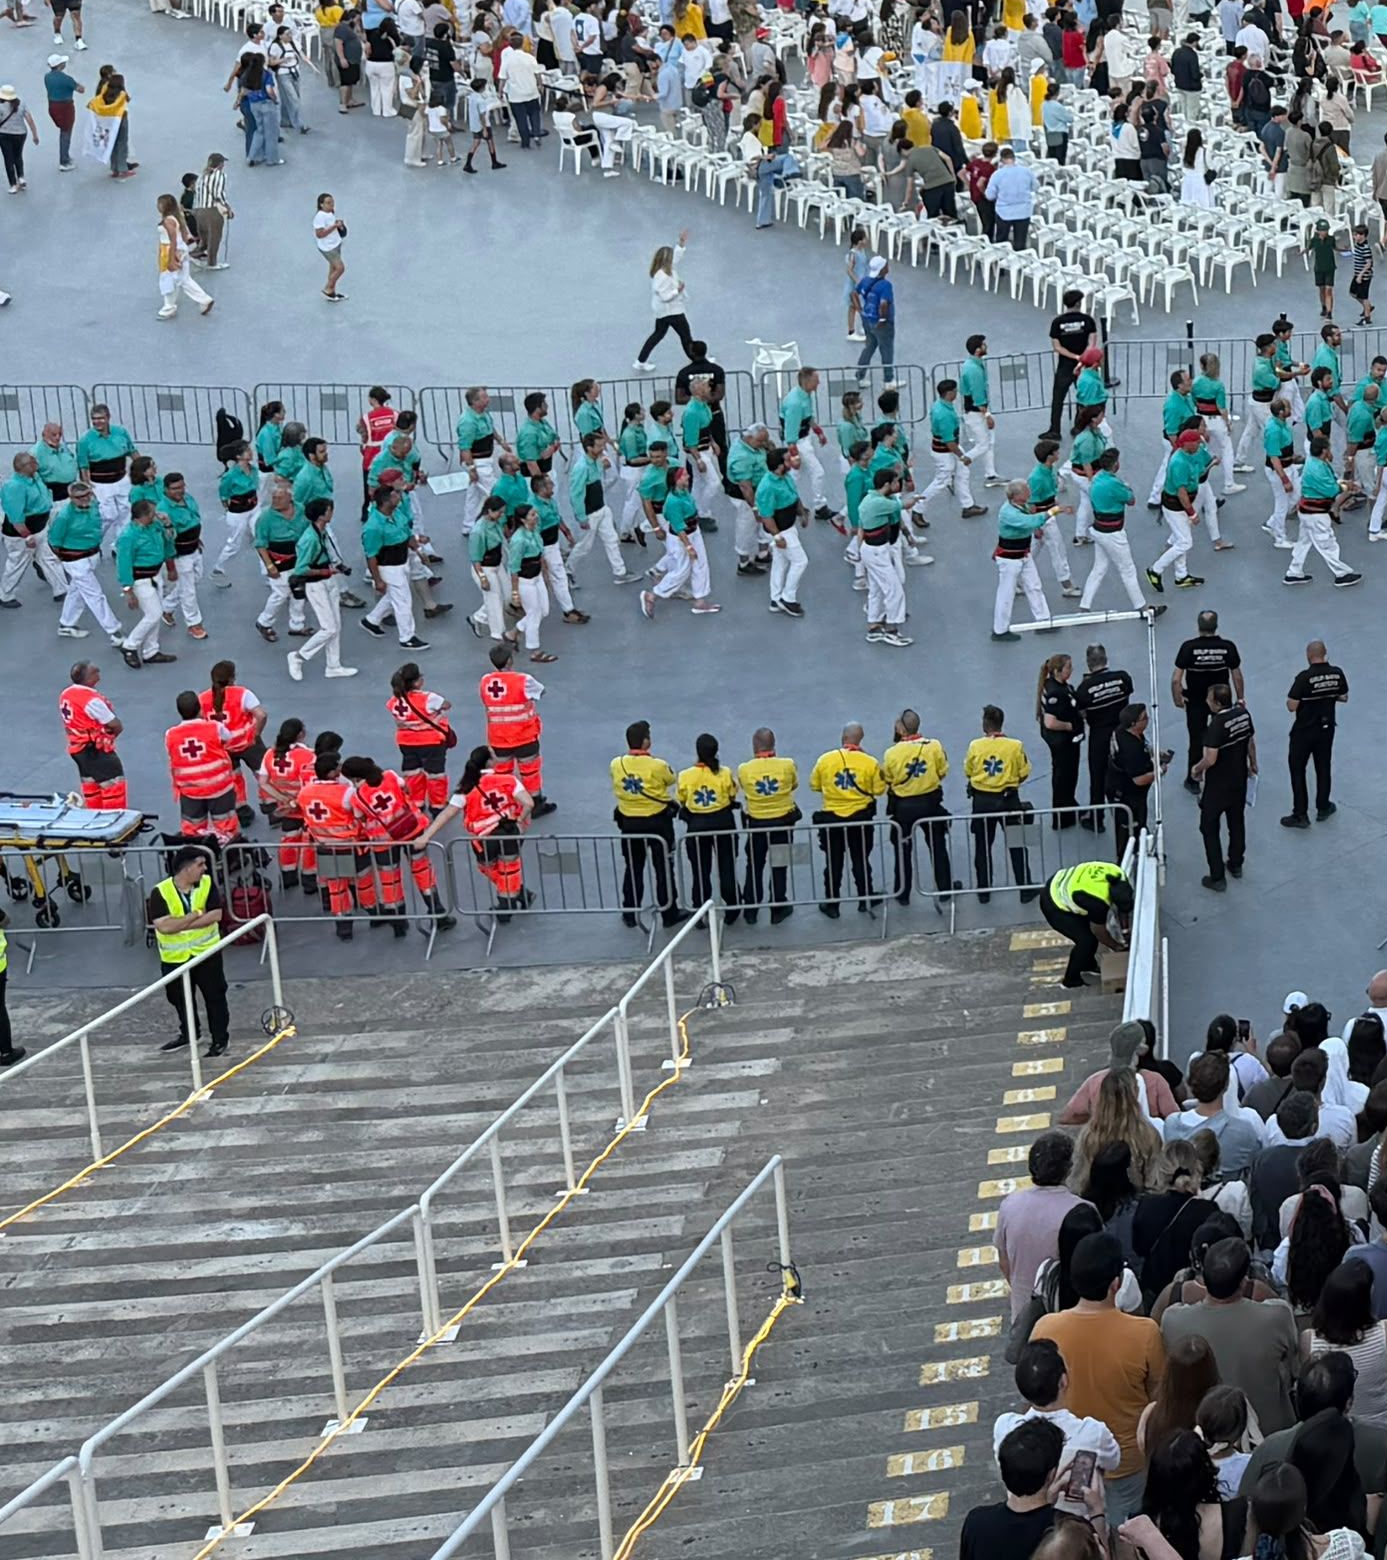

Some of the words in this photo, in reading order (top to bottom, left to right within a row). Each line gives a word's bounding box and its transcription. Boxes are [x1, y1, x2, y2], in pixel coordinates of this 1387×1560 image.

[1013, 1115, 1031, 1130] 7
[997, 1179, 1016, 1194] 9
[962, 1279, 1006, 1301] 12
[919, 1403, 968, 1430] 15
[899, 1448, 954, 1476] 16
[881, 1495, 937, 1526] 17
